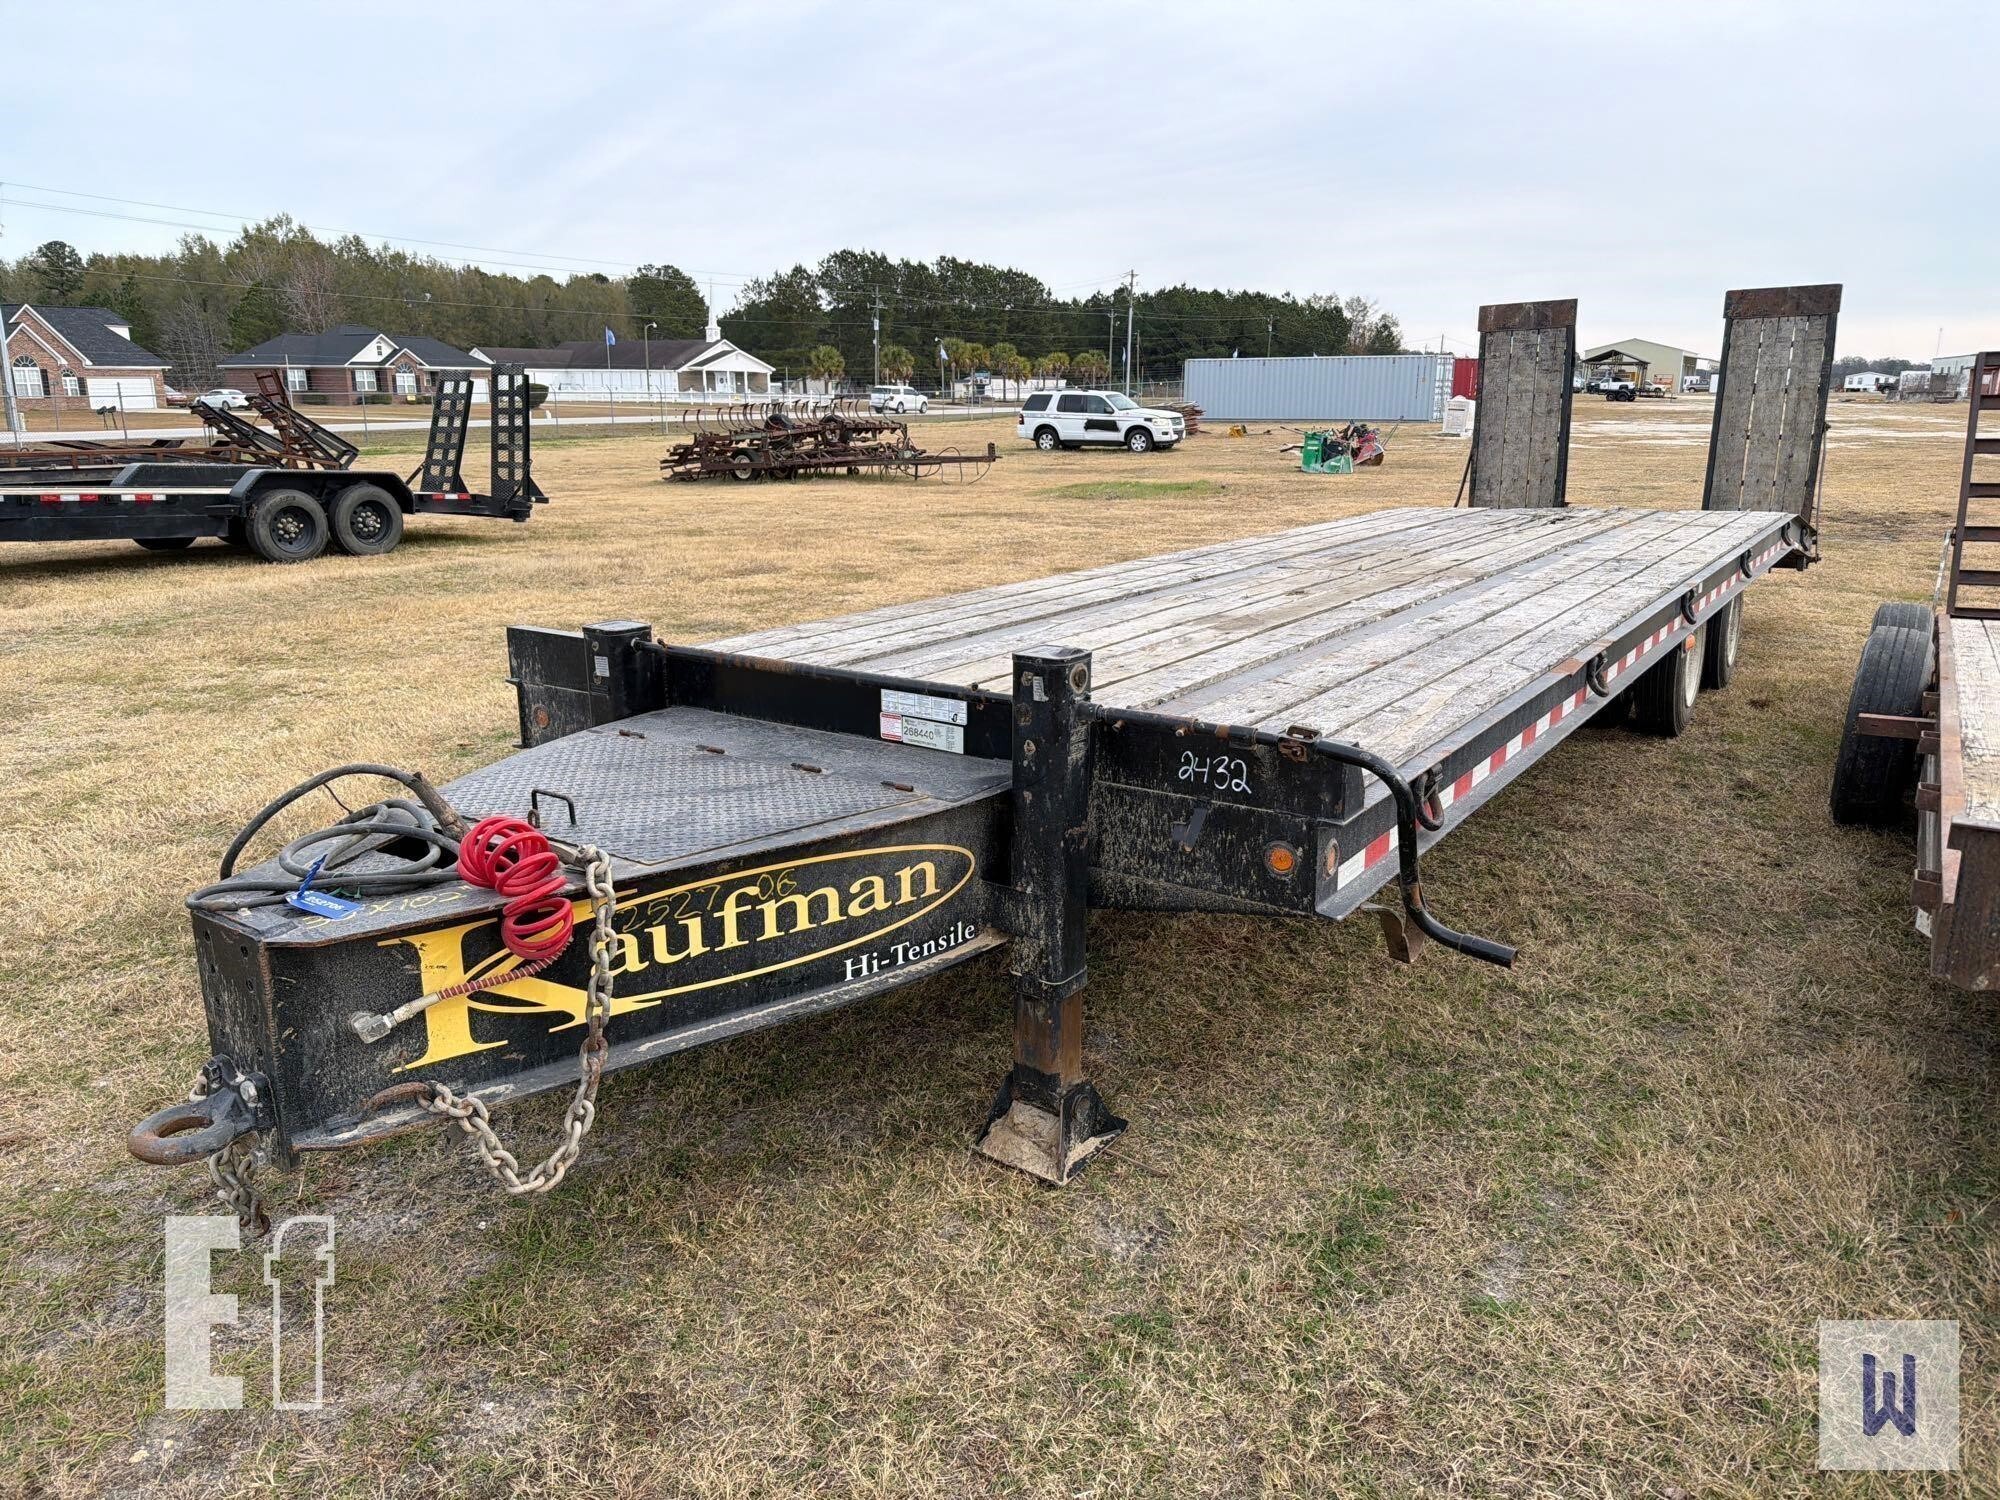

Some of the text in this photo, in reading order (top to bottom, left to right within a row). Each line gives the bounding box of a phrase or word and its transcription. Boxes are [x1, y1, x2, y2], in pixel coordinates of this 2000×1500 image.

[1178, 750, 1253, 795] 2432
[377, 859, 940, 1074] Kaufman
[843, 920, 976, 982] Hi-Tensile
